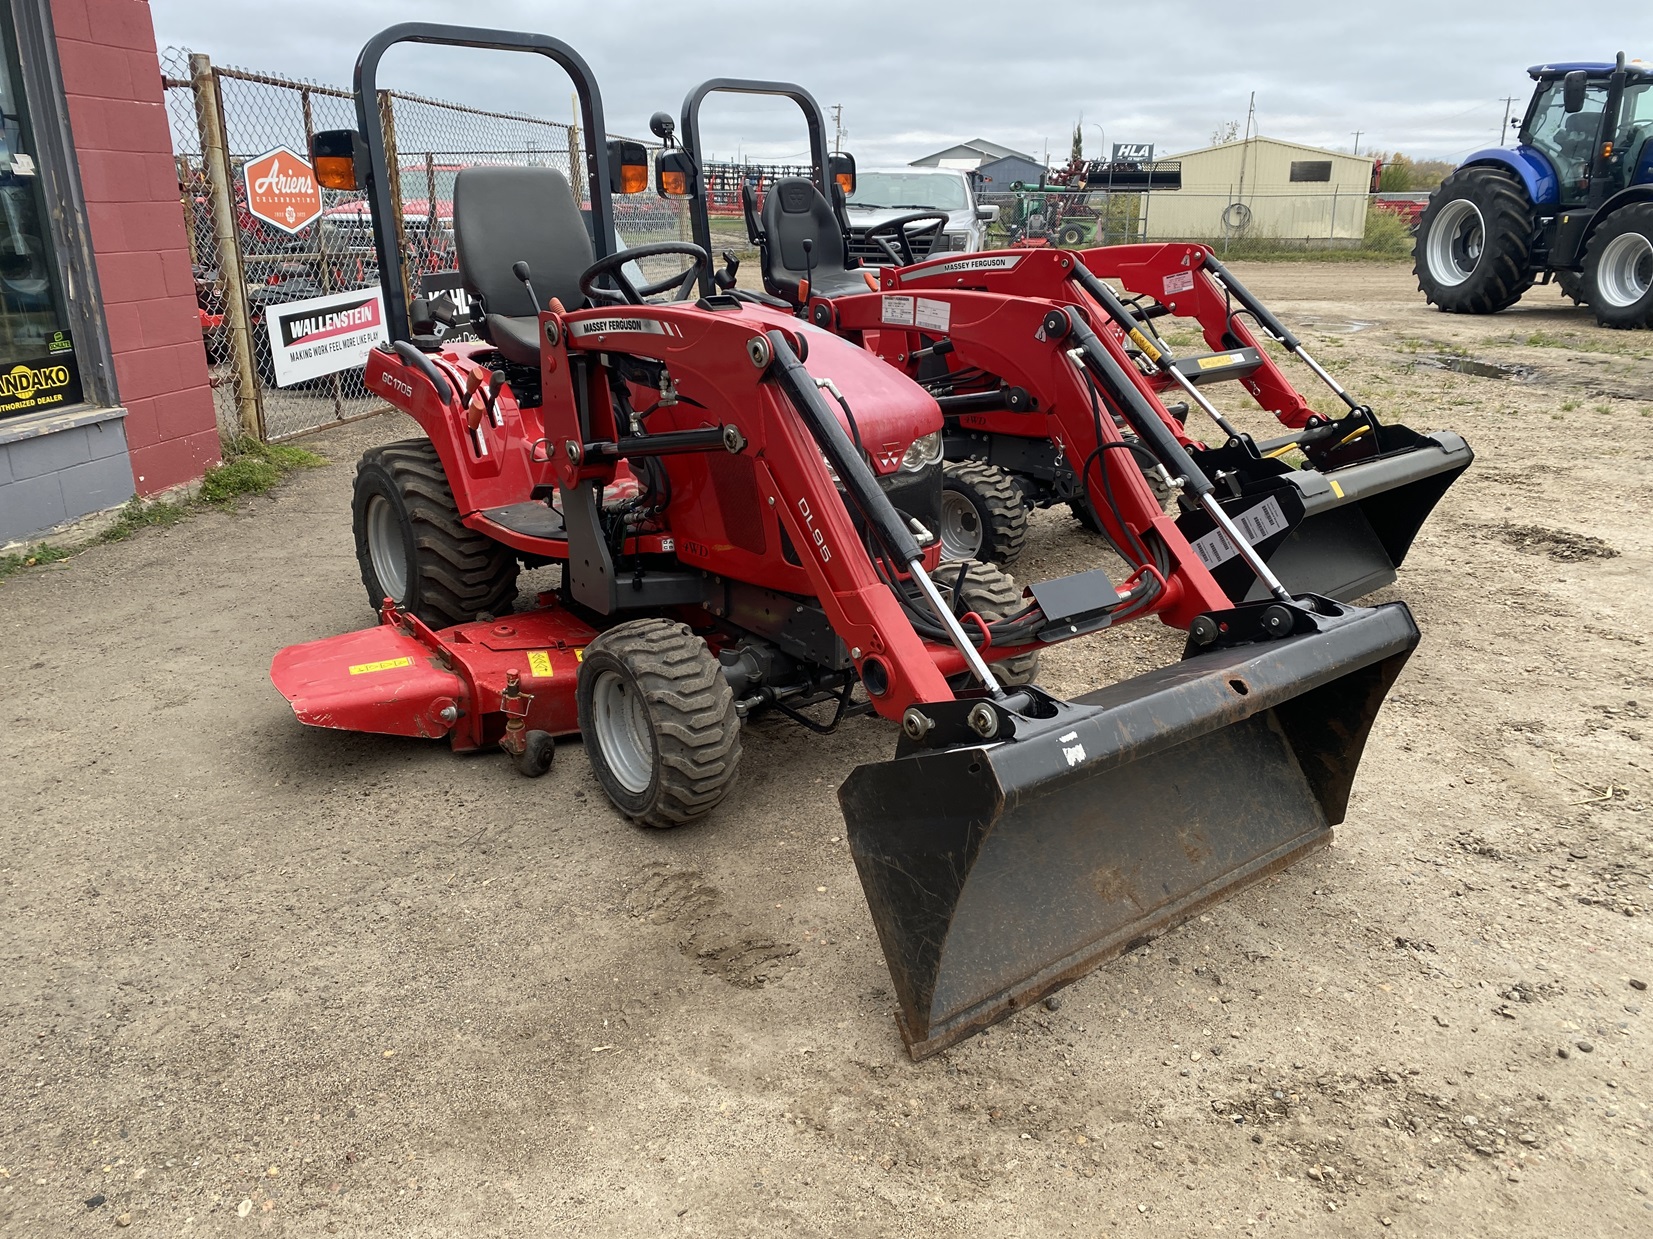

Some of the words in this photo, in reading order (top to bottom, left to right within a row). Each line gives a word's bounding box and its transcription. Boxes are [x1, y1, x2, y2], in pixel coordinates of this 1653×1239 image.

[1117, 144, 1149, 157] HLA
[255, 158, 314, 195] Ariens
[944, 261, 969, 271] MASSEY
[971, 259, 1006, 268] FERGUSON
[290, 305, 372, 338] WALLENSTEIN
[583, 321, 608, 333] MASSEY
[608, 320, 642, 332] FERGUSON
[290, 348, 313, 362] MAKING
[313, 345, 328, 357] WORK
[329, 342, 342, 353] FEEL
[342, 339, 356, 349] MORE
[357, 334, 367, 346] LIKE
[368, 331, 379, 343] PLAY
[381, 371, 413, 398] GC1705
[37, 394, 63, 405] DEALER
